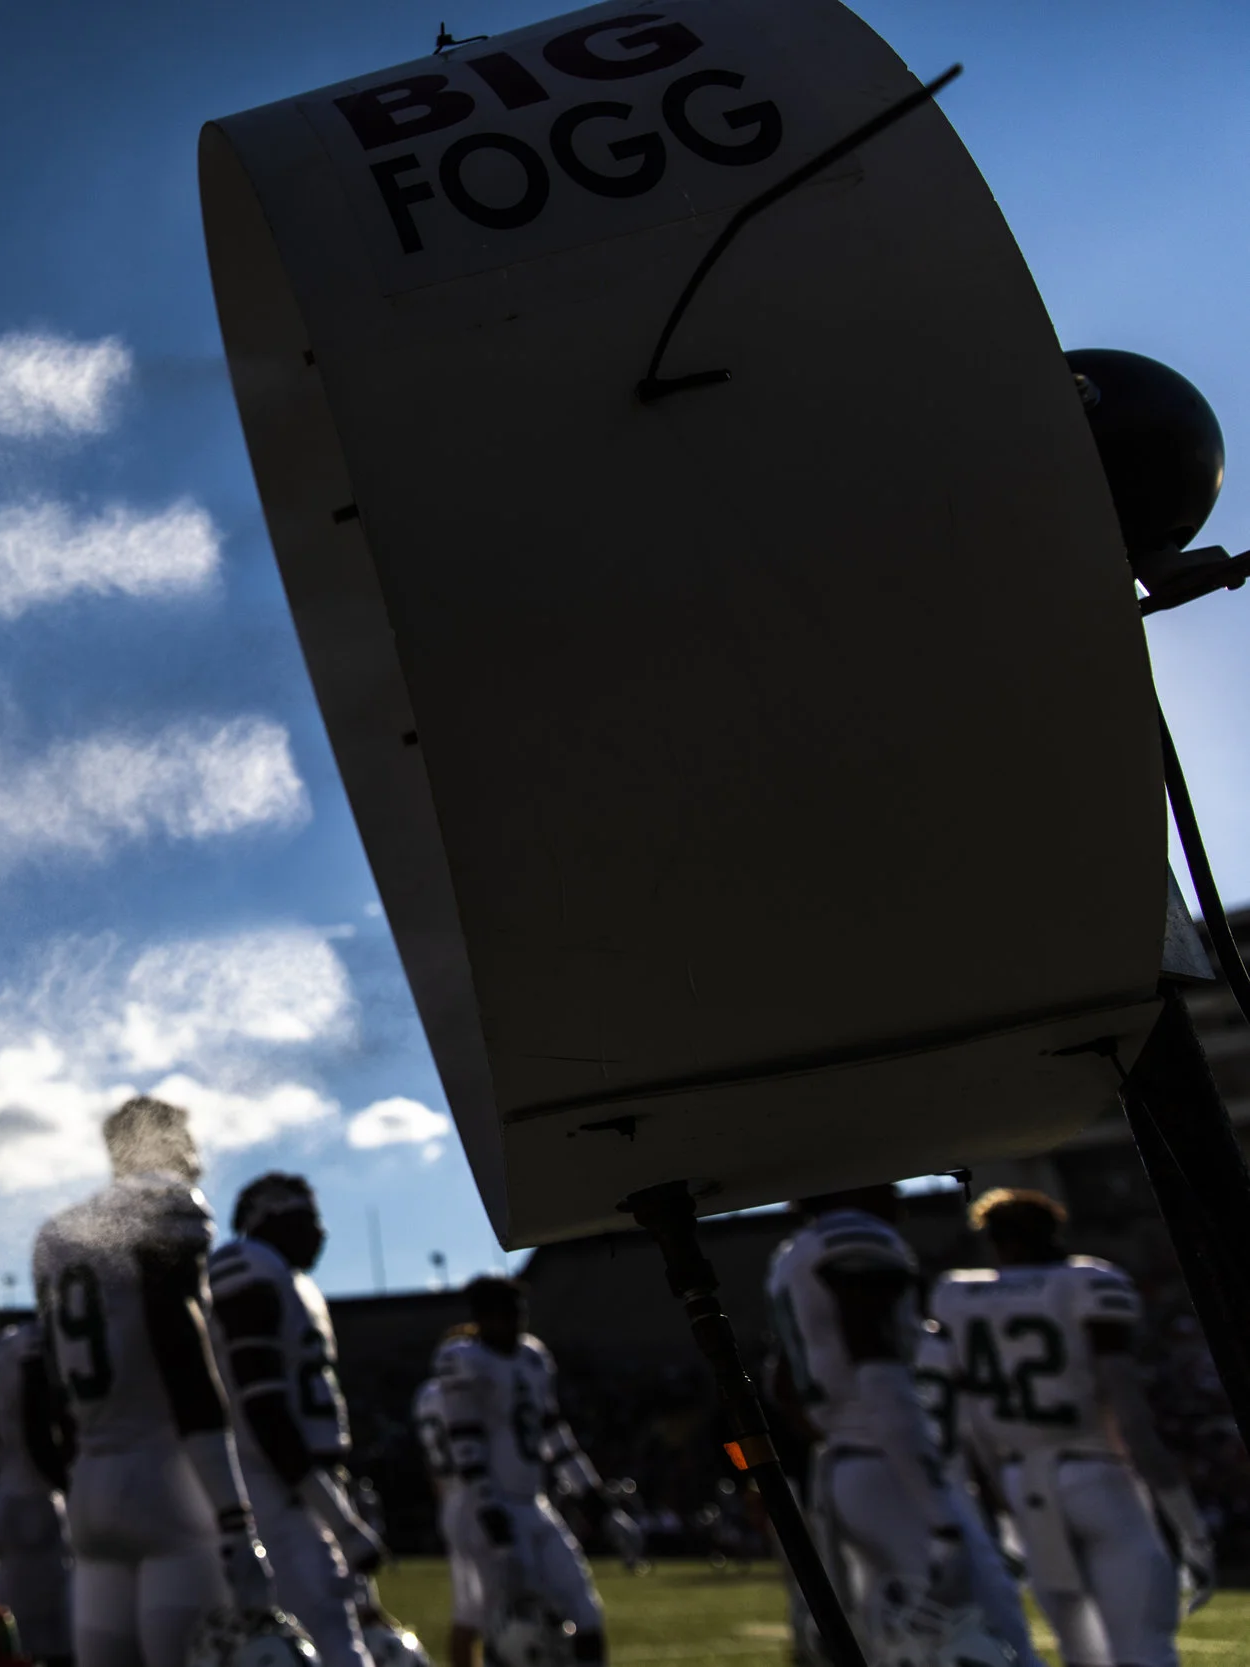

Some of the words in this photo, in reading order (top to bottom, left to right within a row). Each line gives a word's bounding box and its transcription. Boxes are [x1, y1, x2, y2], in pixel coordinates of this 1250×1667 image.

[332, 13, 705, 150] BIG
[369, 69, 784, 254] FOGG
[959, 1317, 1078, 1424] 42
